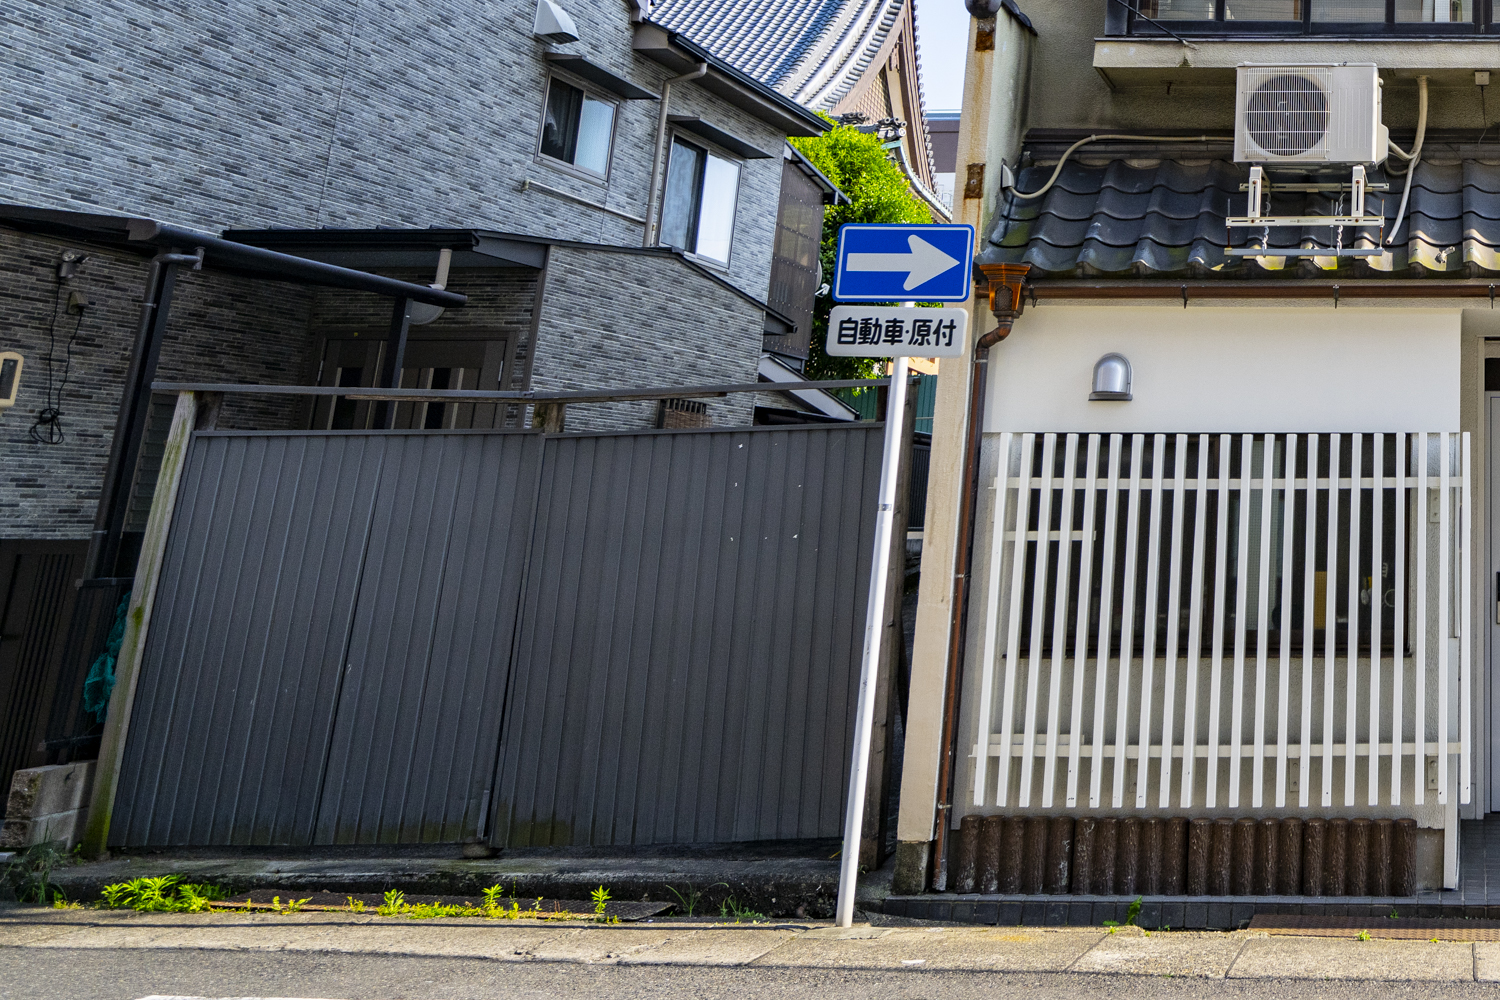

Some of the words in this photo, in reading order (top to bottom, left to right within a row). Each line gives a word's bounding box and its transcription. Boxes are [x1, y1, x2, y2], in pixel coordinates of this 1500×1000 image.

[837, 316, 957, 347] 自動車・原付
